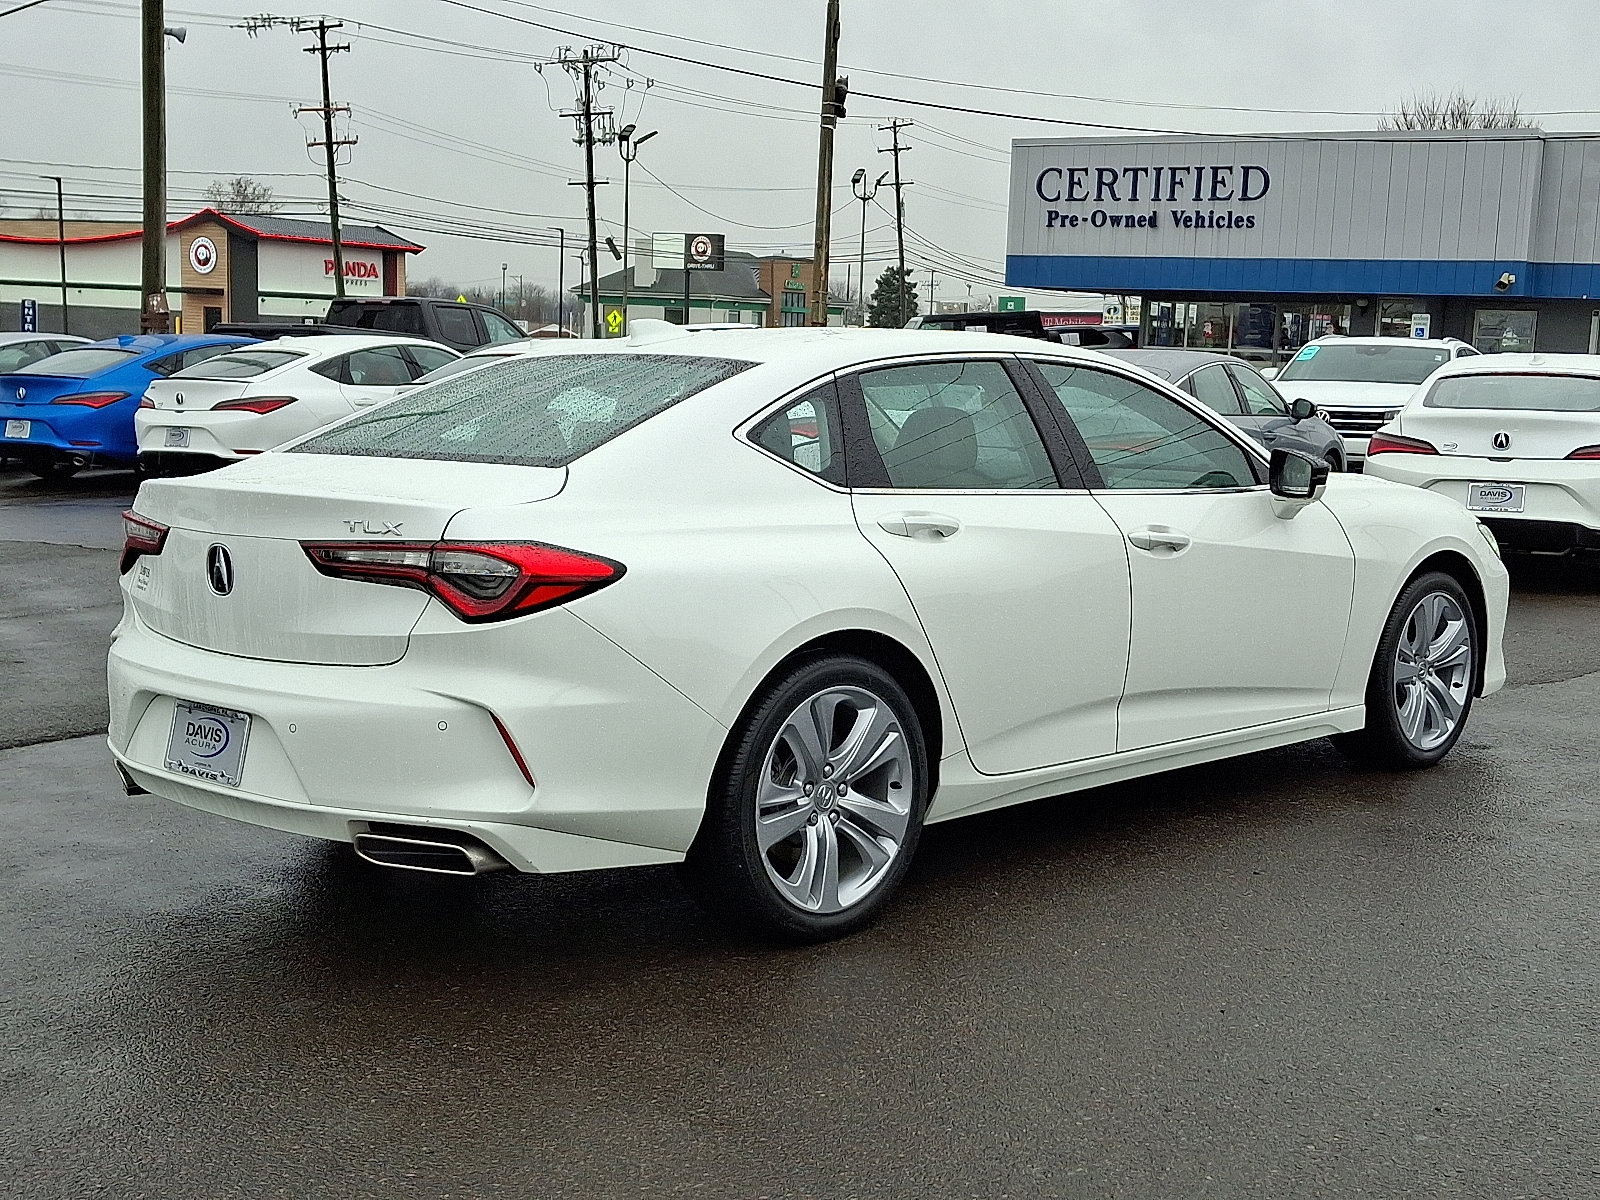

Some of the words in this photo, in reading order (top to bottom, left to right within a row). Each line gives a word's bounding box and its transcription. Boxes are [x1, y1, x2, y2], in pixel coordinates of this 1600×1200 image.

[1036, 165, 1271, 202] CERTIFIED
[1046, 210, 1158, 228] Pre-Owned
[1171, 210, 1256, 229] Vehicles
[324, 259, 379, 278] PNDA
[1480, 490, 1507, 498] DAVIS
[342, 519, 403, 537] TLX
[186, 721, 223, 743] DAVIS
[184, 737, 217, 751] ACURA
[181, 766, 218, 781] DAVIS
